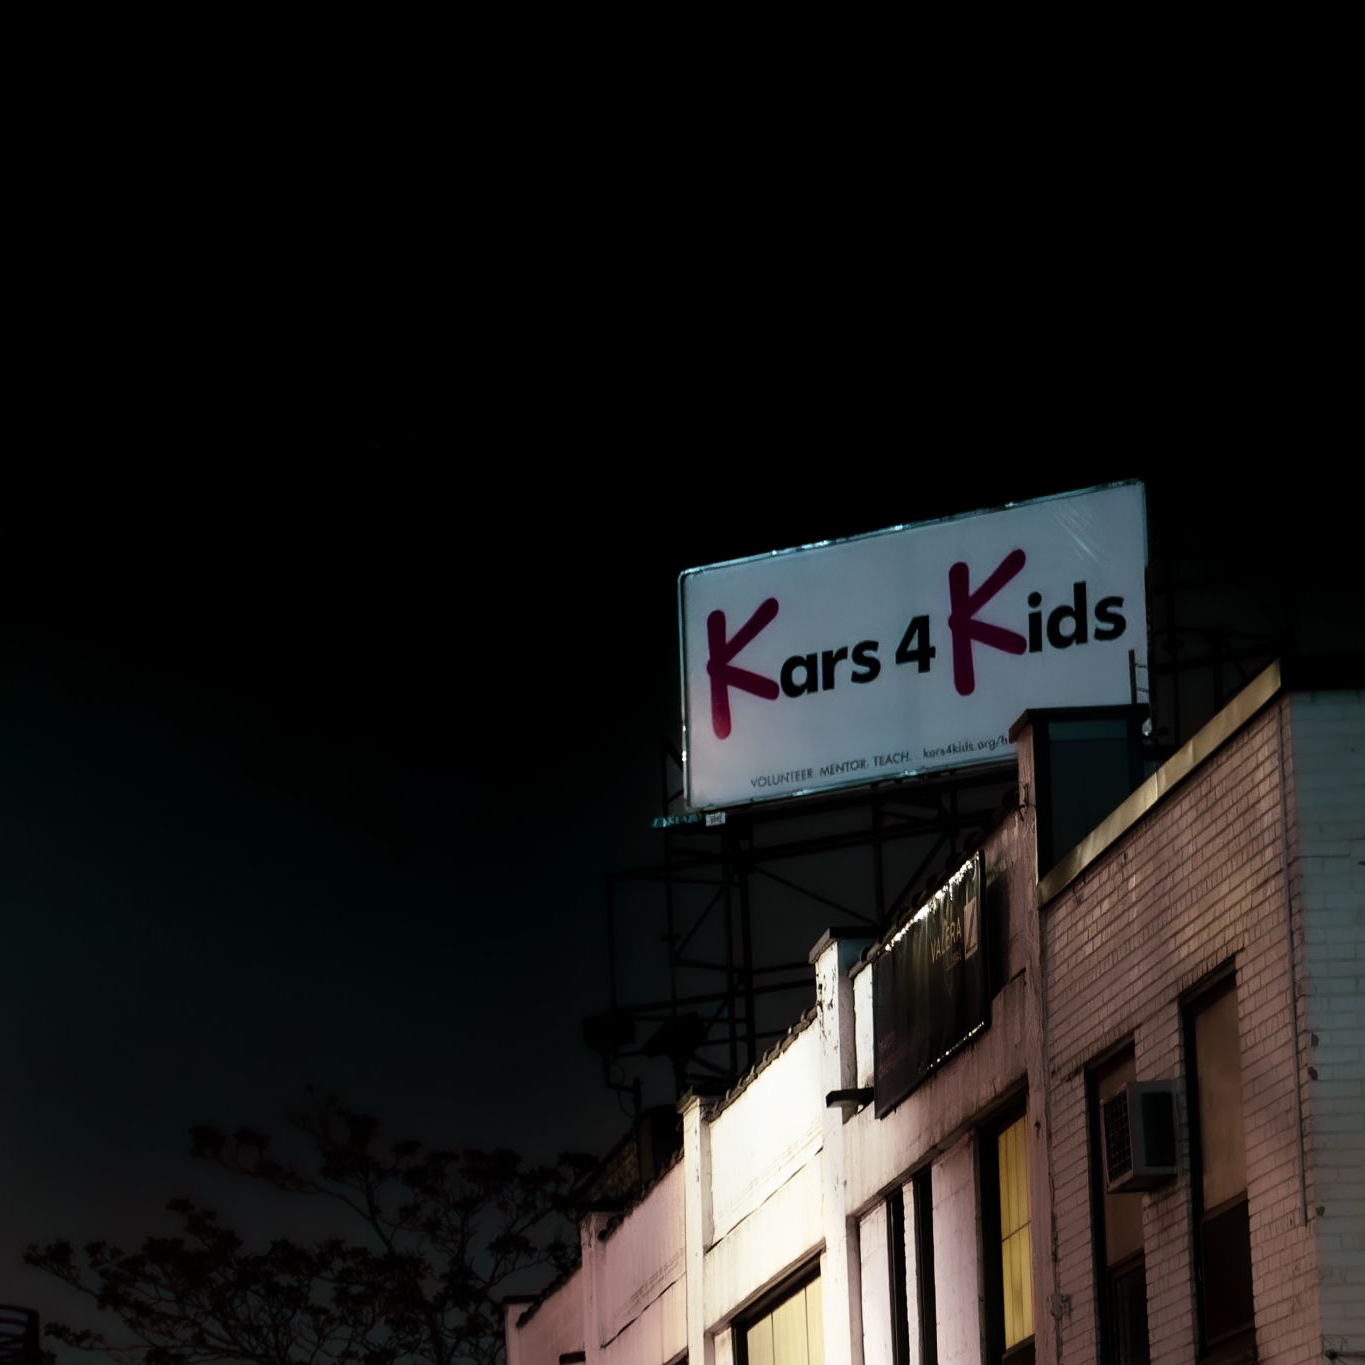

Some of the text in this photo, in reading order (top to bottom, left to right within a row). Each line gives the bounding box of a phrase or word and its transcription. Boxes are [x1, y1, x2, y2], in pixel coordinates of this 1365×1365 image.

[706, 549, 1126, 739] Kars 4 Kids
